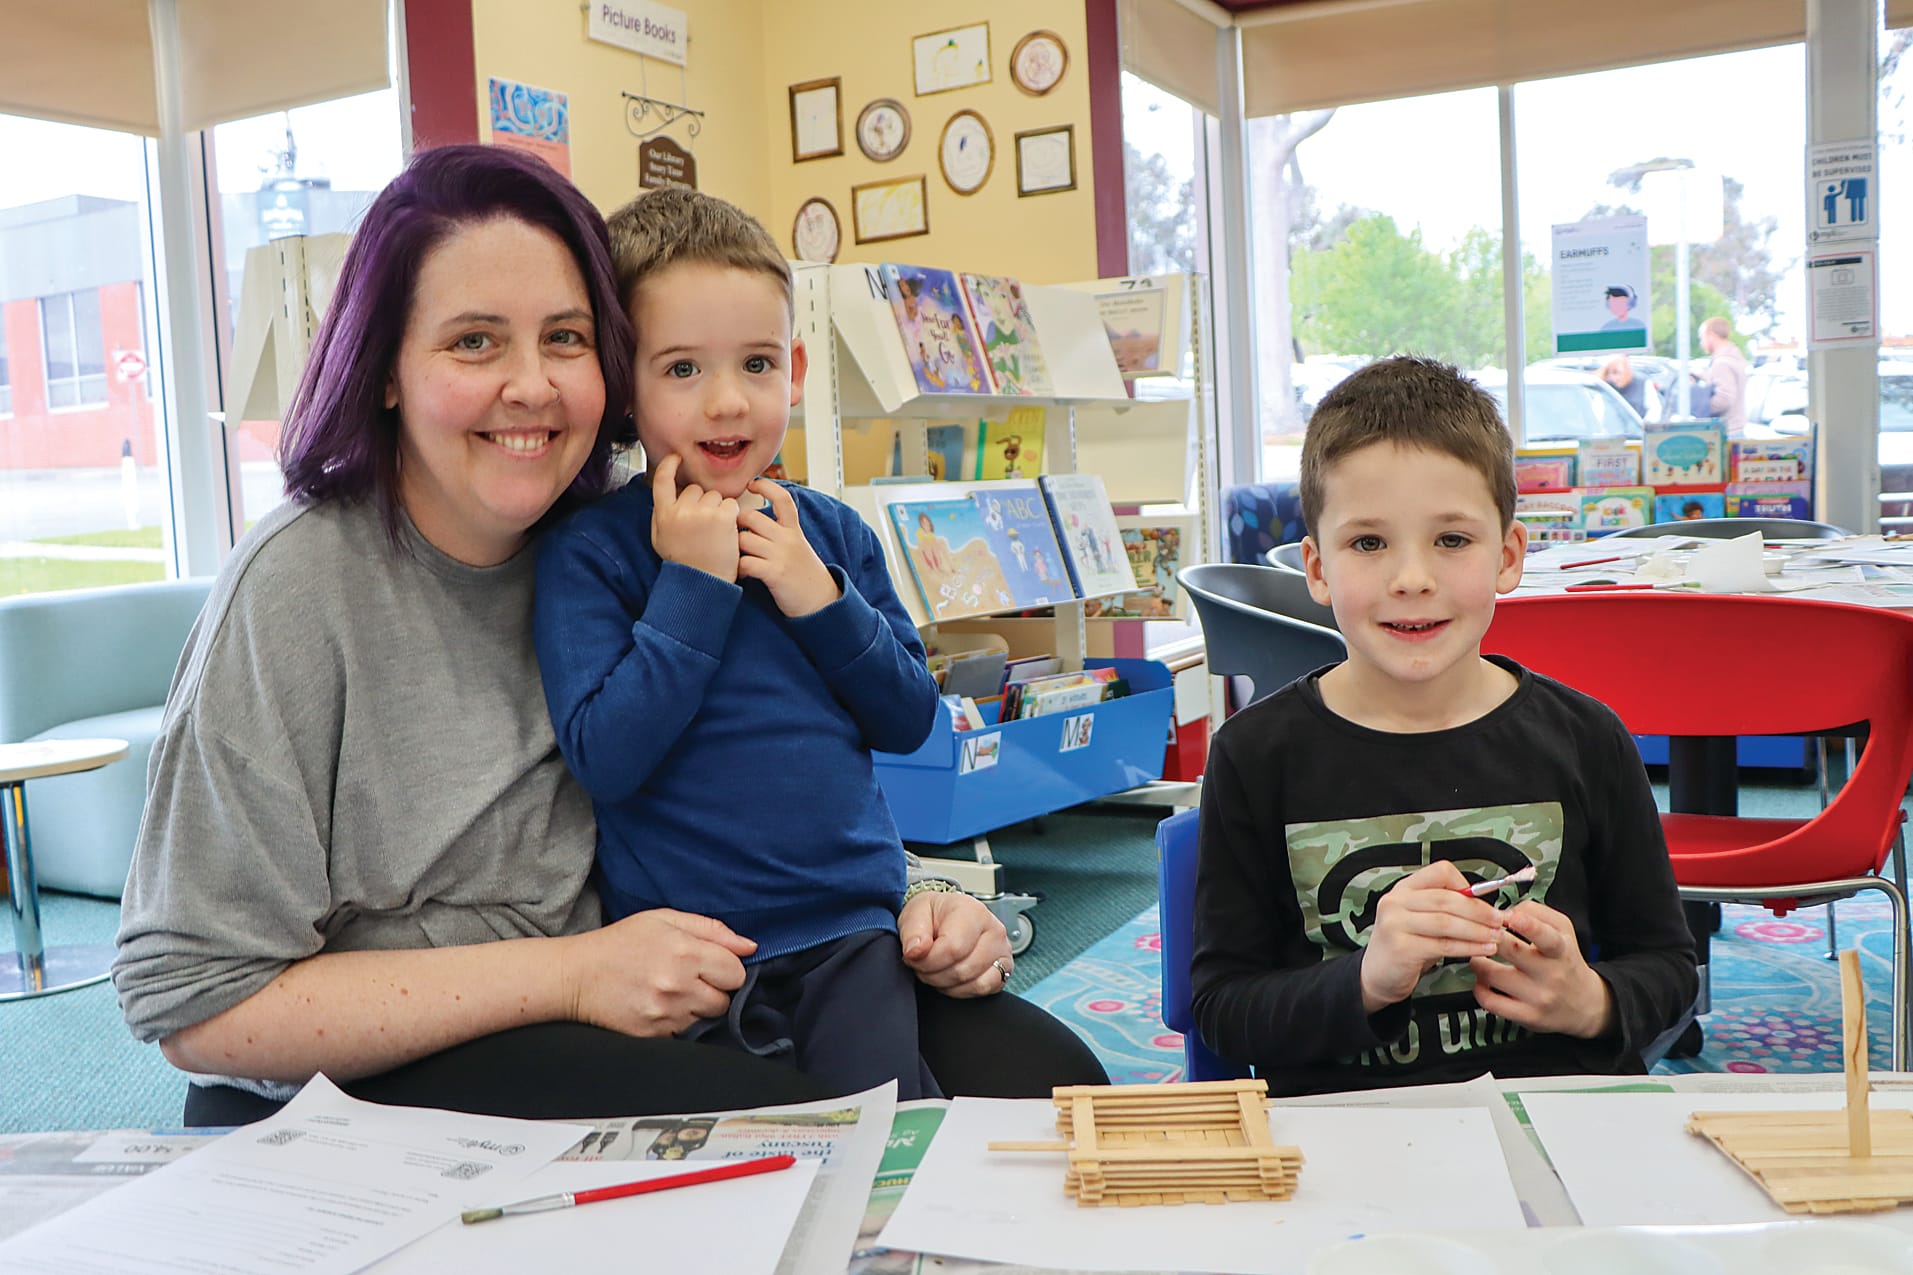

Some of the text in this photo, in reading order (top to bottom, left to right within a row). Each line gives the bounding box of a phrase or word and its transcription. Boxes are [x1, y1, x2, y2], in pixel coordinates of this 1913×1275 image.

[603, 4, 676, 44] Picture Books
[663, 152, 685, 167] Library
[1812, 152, 1872, 166] CHILDREN MUST
[1812, 165, 1872, 178] BE SUPERVISED
[1560, 247, 1609, 259] EARMUFFS
[938, 341, 955, 364] Go
[1597, 457, 1628, 468] FIRST
[1779, 465, 1792, 473] THE
[1005, 497, 1042, 521] ABC
[1060, 716, 1081, 750] M
[960, 737, 978, 773] N
[757, 1140, 832, 1148] Tuscany
[720, 1151, 744, 1160] of
[800, 1149, 832, 1157] the
